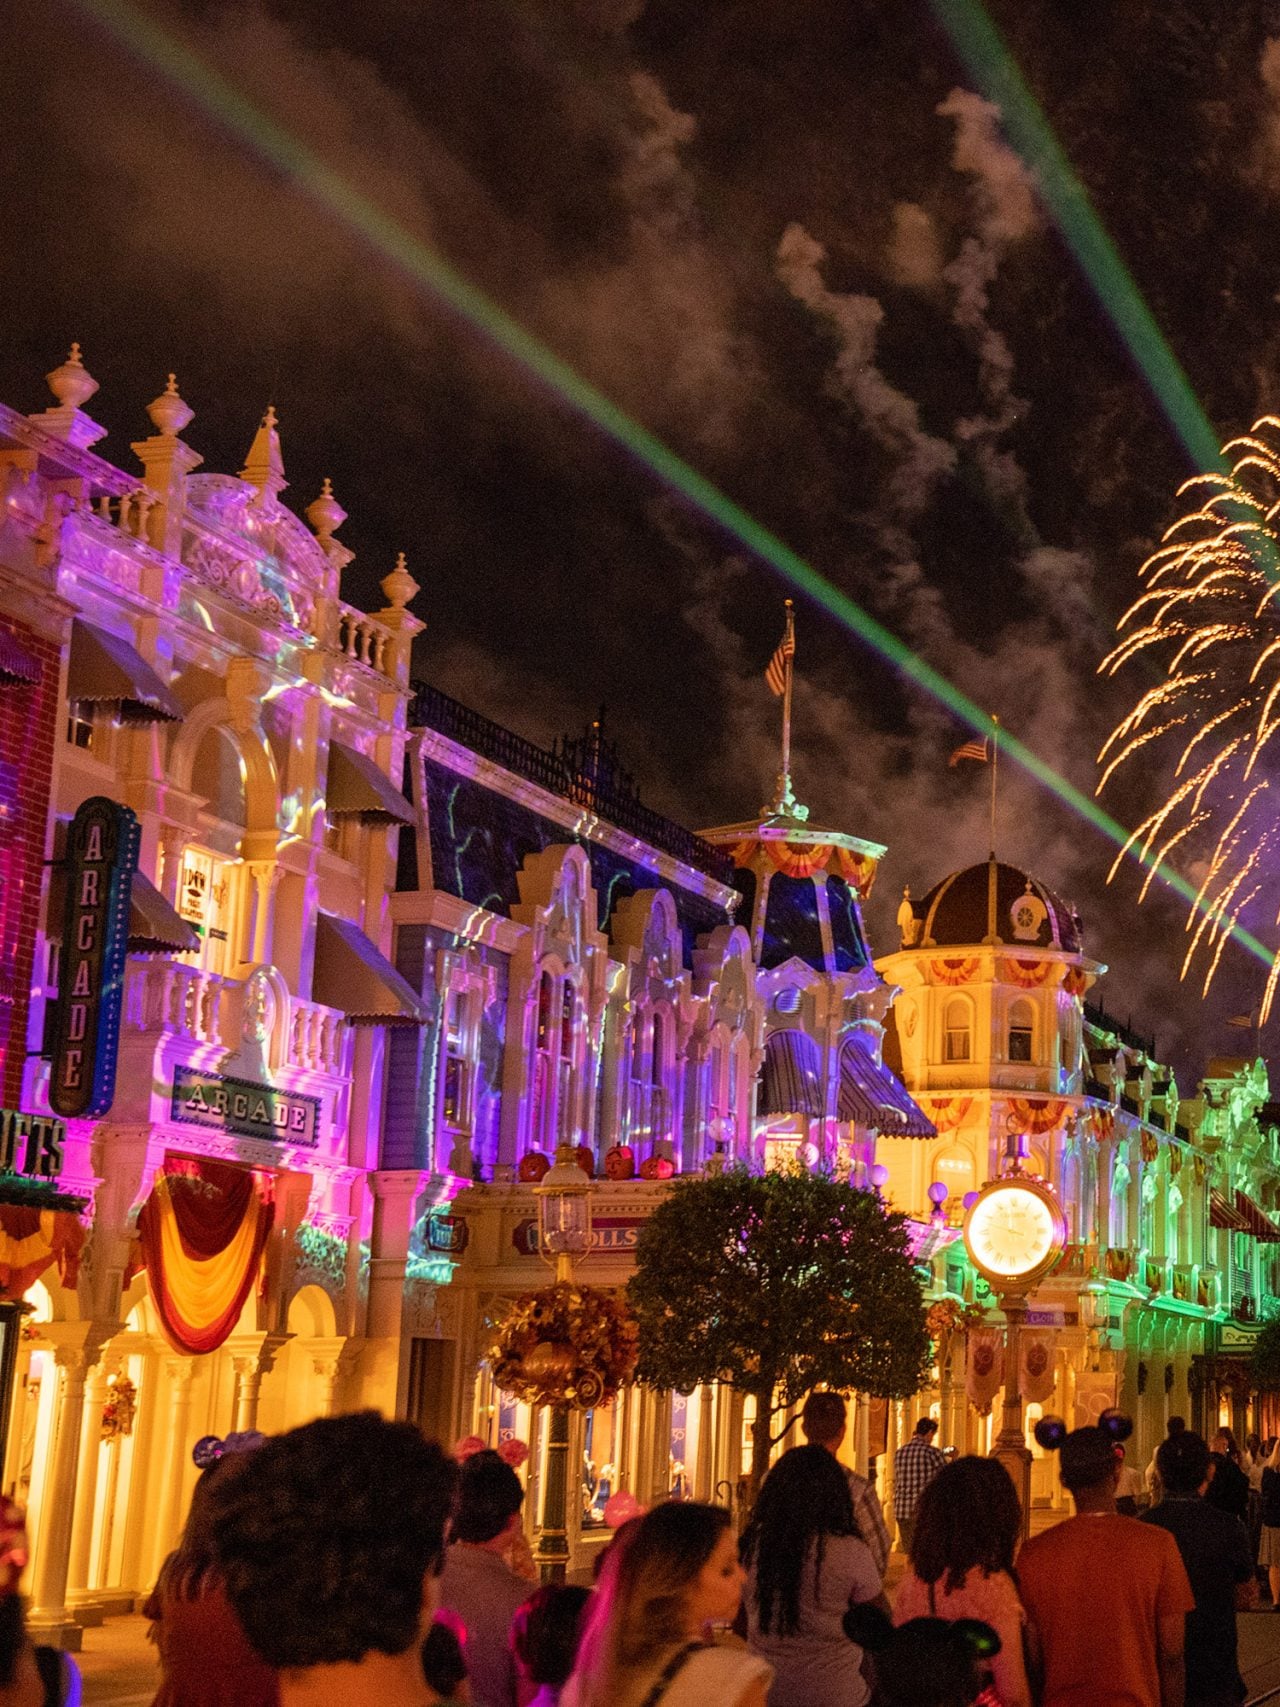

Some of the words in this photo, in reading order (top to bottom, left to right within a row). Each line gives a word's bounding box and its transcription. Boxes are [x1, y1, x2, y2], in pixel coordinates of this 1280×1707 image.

[63, 825, 103, 1087] ARCADE
[185, 1083, 305, 1131] ARCADE
[584, 1230, 637, 1247] OLLS
